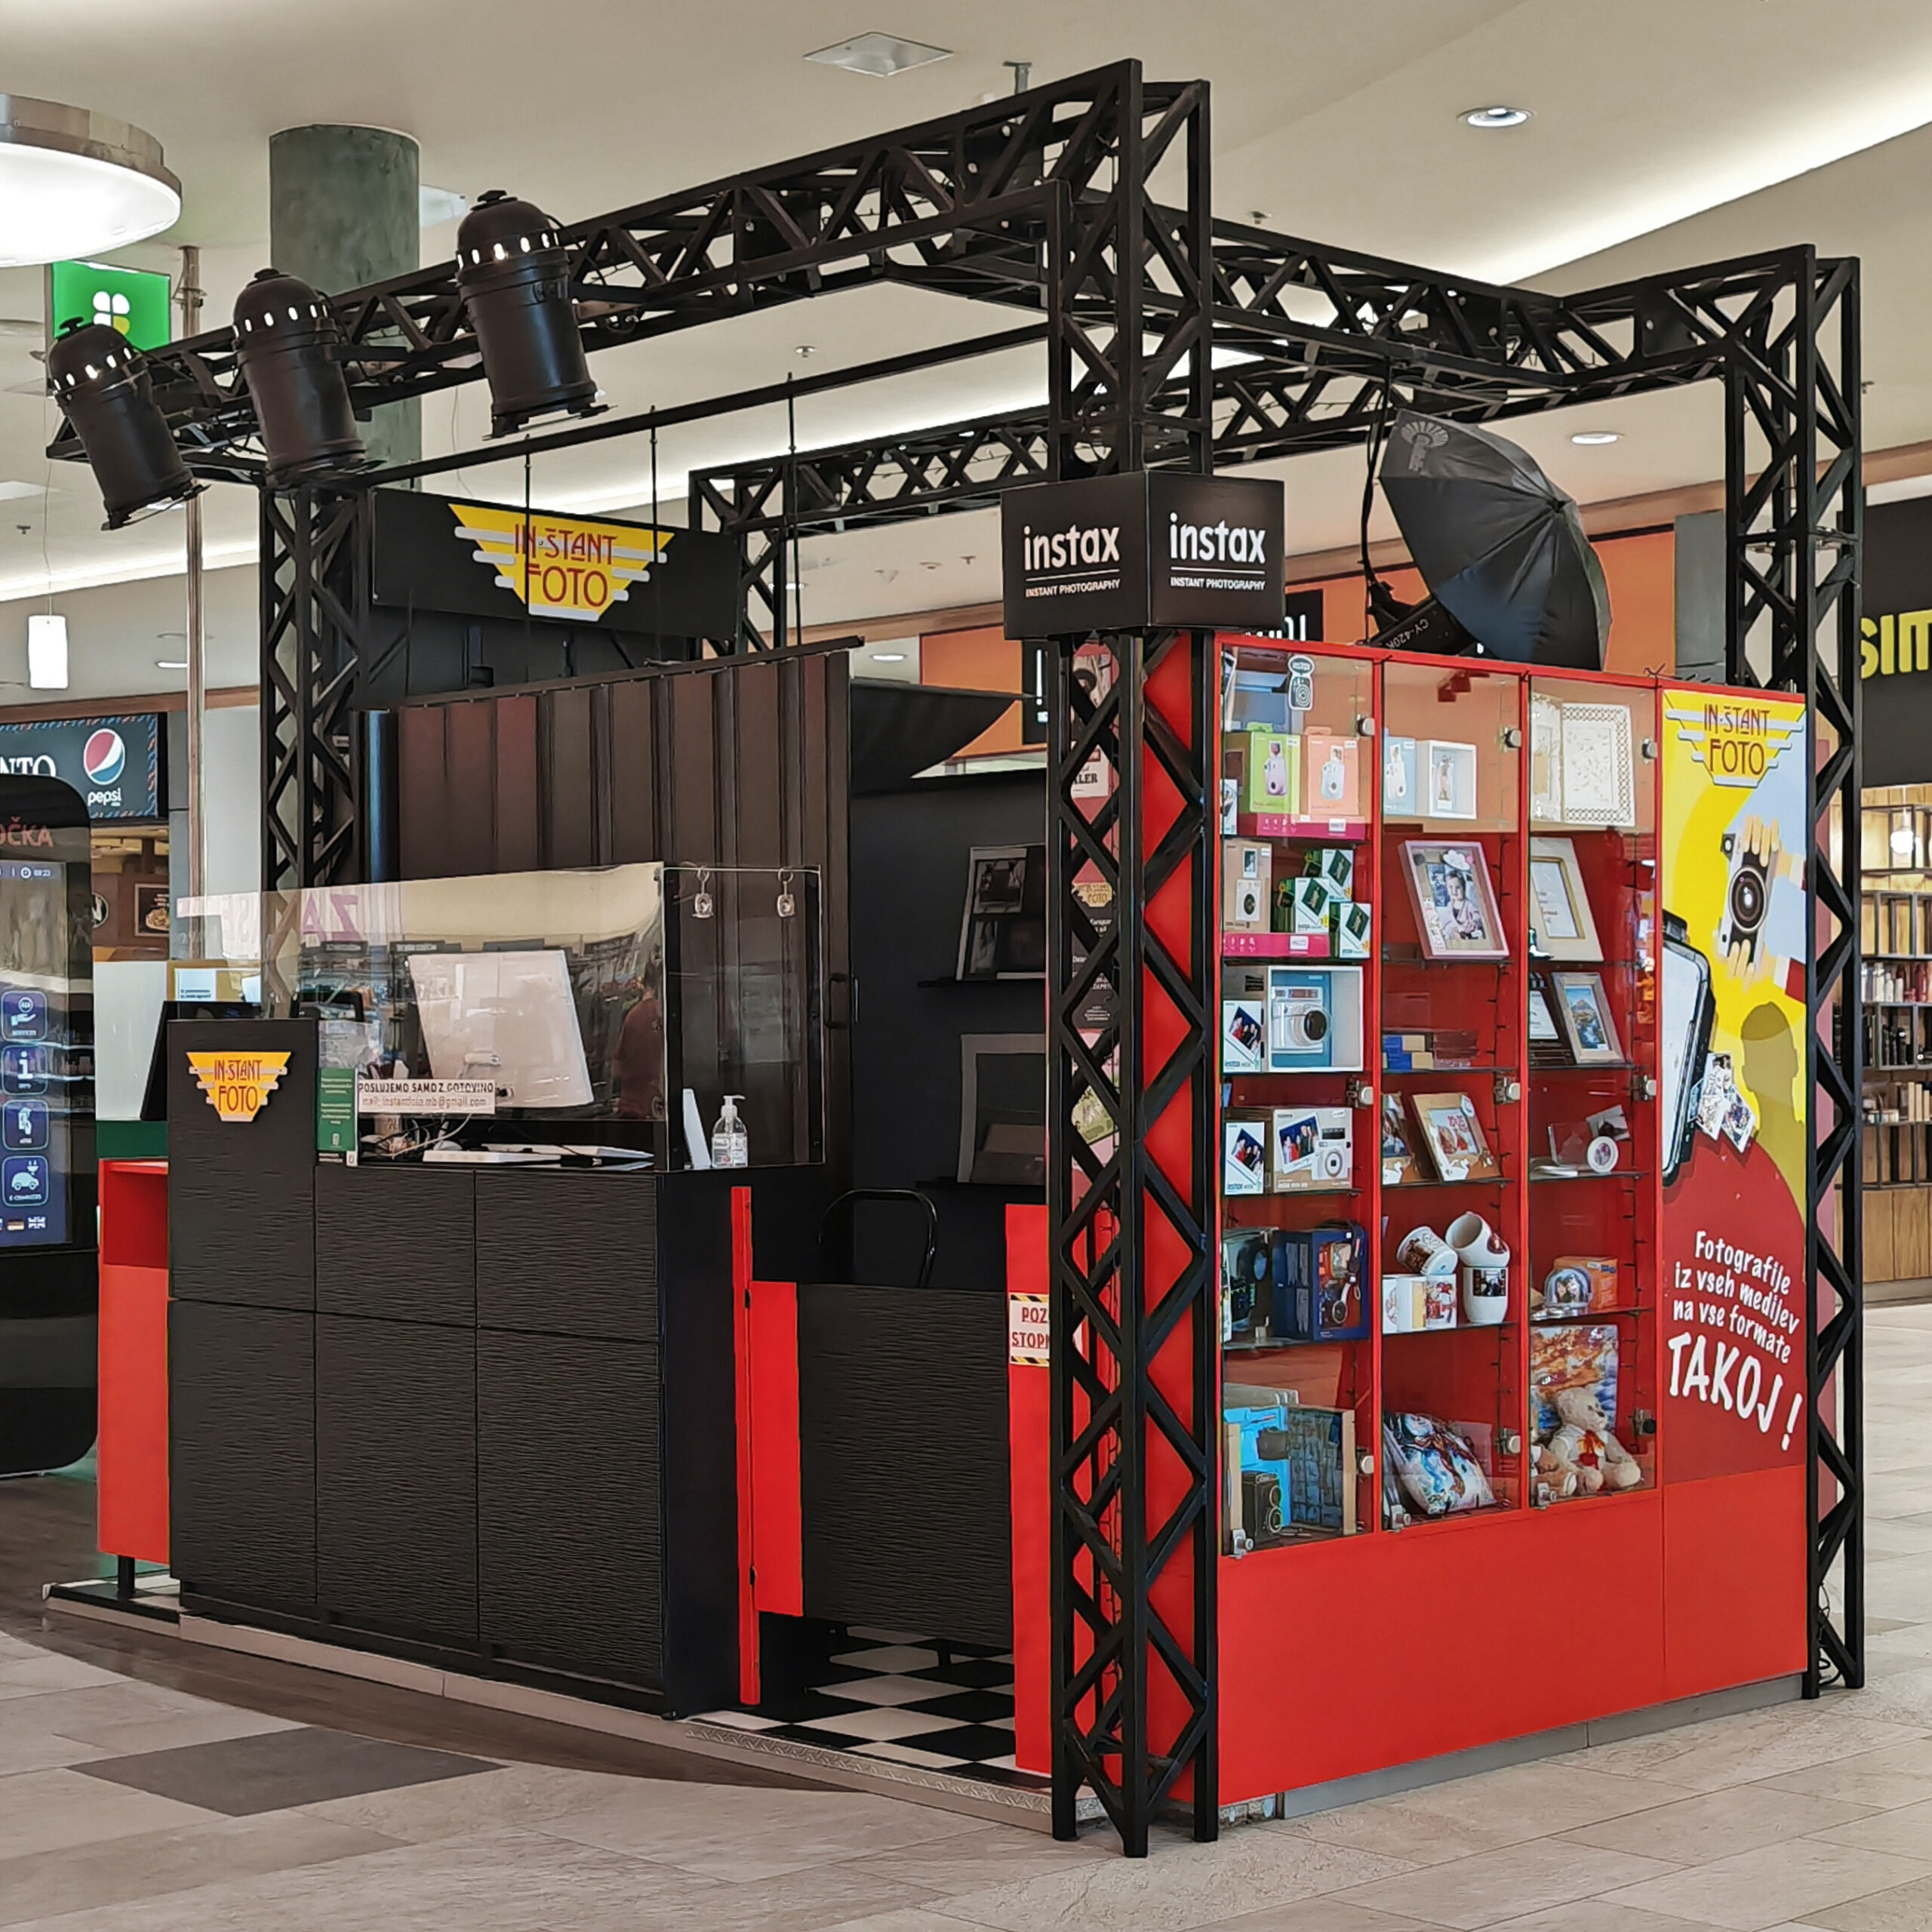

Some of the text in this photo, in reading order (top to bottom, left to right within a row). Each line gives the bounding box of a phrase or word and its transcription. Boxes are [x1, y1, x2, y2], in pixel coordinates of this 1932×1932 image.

[1024, 525, 1120, 571] instax
[1171, 512, 1266, 564] instax
[526, 562, 608, 607] FOTO
[1026, 579, 1120, 598] INSTANT PHOTOGRAPHY
[1171, 577, 1266, 590] INSTANT PHOTOGRAPHY
[1710, 738, 1765, 775] FOTO
[88, 788, 122, 806] pepsi
[218, 1085, 258, 1112] FOTO
[412, 1082, 437, 1093] SAMO
[438, 1082, 444, 1093] Z
[1695, 1230, 1792, 1295] Fotografije
[1675, 1260, 1800, 1334] iz vseh medijev
[1673, 1299, 1792, 1364] na vse formate
